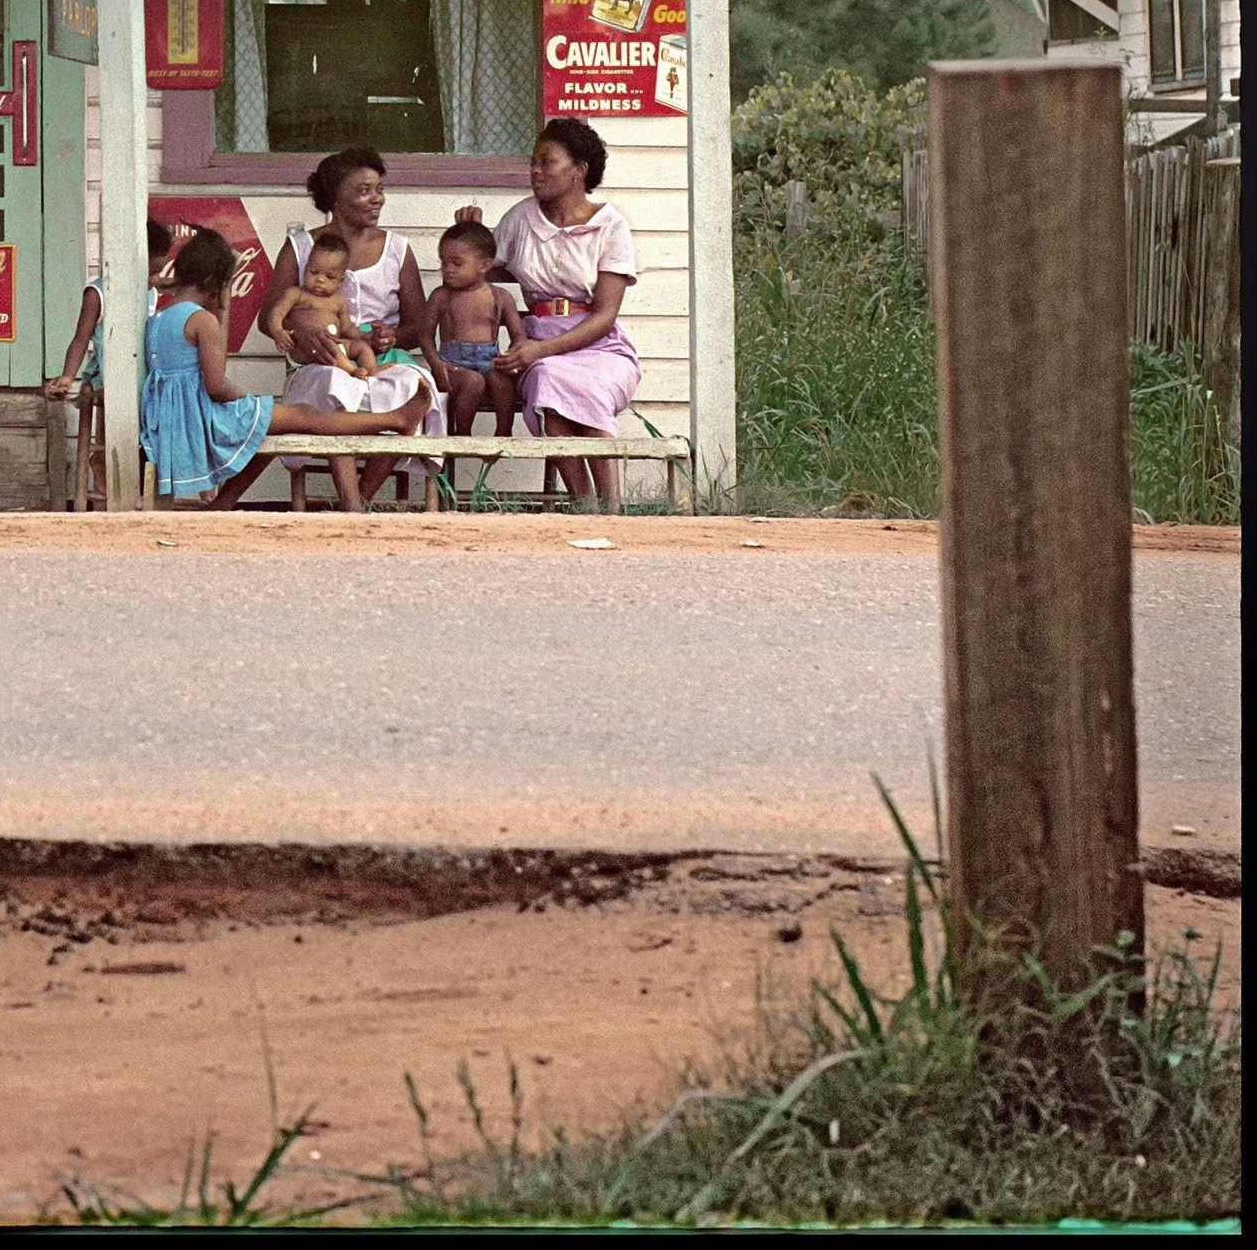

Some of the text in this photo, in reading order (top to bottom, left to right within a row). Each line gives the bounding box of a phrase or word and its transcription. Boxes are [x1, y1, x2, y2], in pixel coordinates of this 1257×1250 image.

[653, 4, 687, 23] Goo
[546, 34, 656, 70] CAVALIER
[558, 99, 642, 111] MILDNESS
